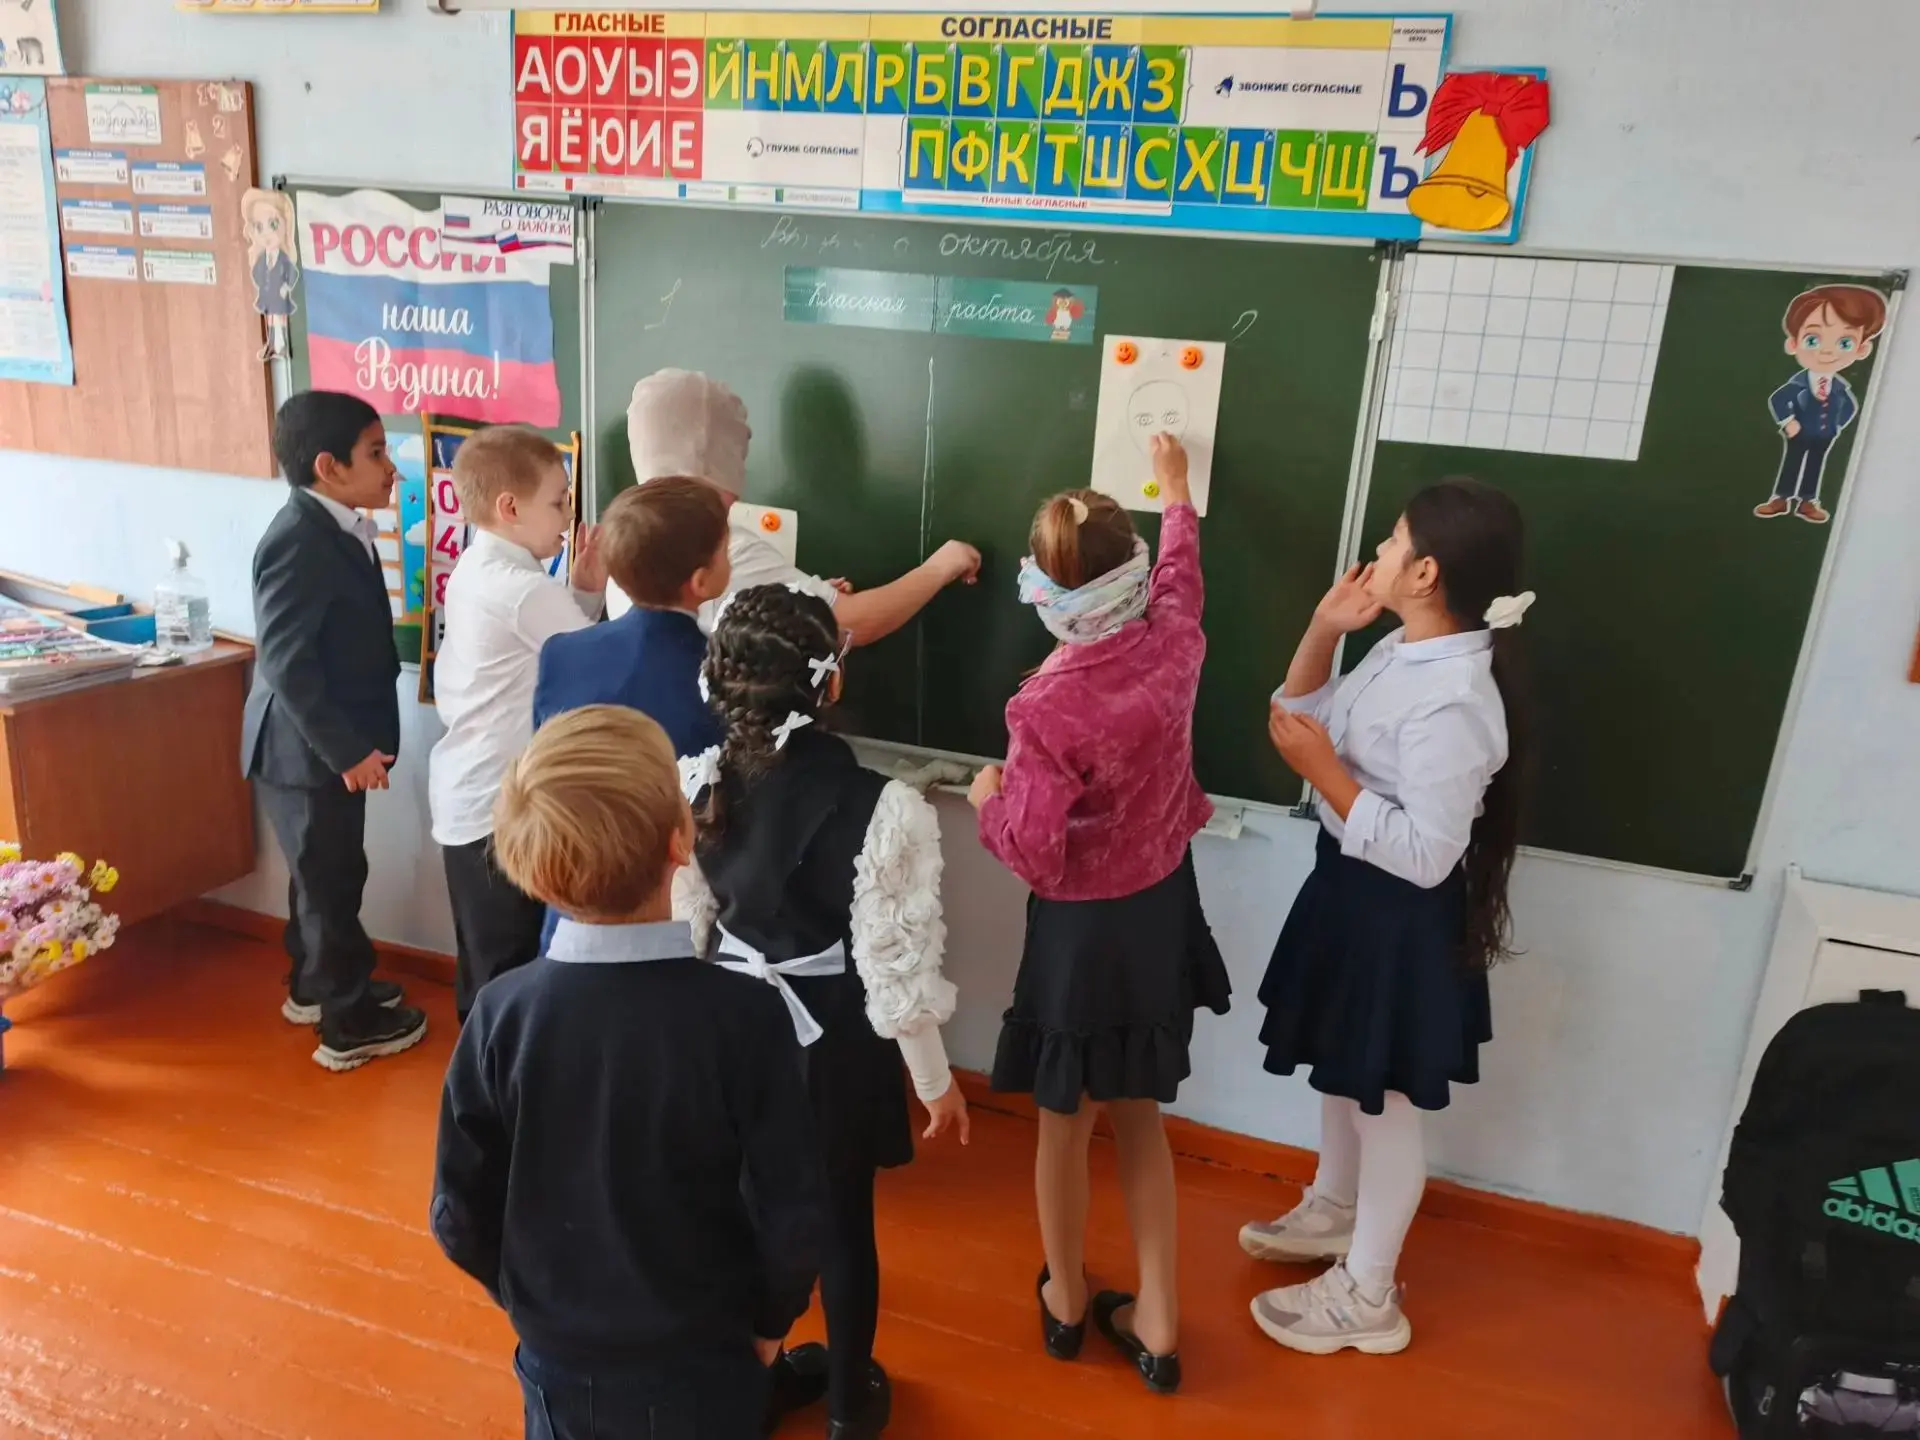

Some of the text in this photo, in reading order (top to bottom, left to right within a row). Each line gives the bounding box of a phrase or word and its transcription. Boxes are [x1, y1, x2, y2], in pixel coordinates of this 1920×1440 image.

[554, 12, 665, 33] ГЛАСНЫЕ
[941, 16, 1112, 40] СОГЛАСНЫЕ
[1239, 82, 1363, 95] ЗВОНКИЕ СОГЛАСНЫЕ
[766, 143, 859, 155] ГЛУХИЕ СОГЛАСНЫЕ
[483, 200, 571, 221] РАЗГОВОРЫ
[982, 196, 1088, 209] ПАРНЫЕ СОГЛАСНЫЕ
[517, 220, 572, 236] ВАЖНОМ
[808, 282, 1036, 327] Классная работа
[382, 301, 474, 335] наша
[354, 336, 501, 411] Родина!
[436, 525, 460, 560] 4
